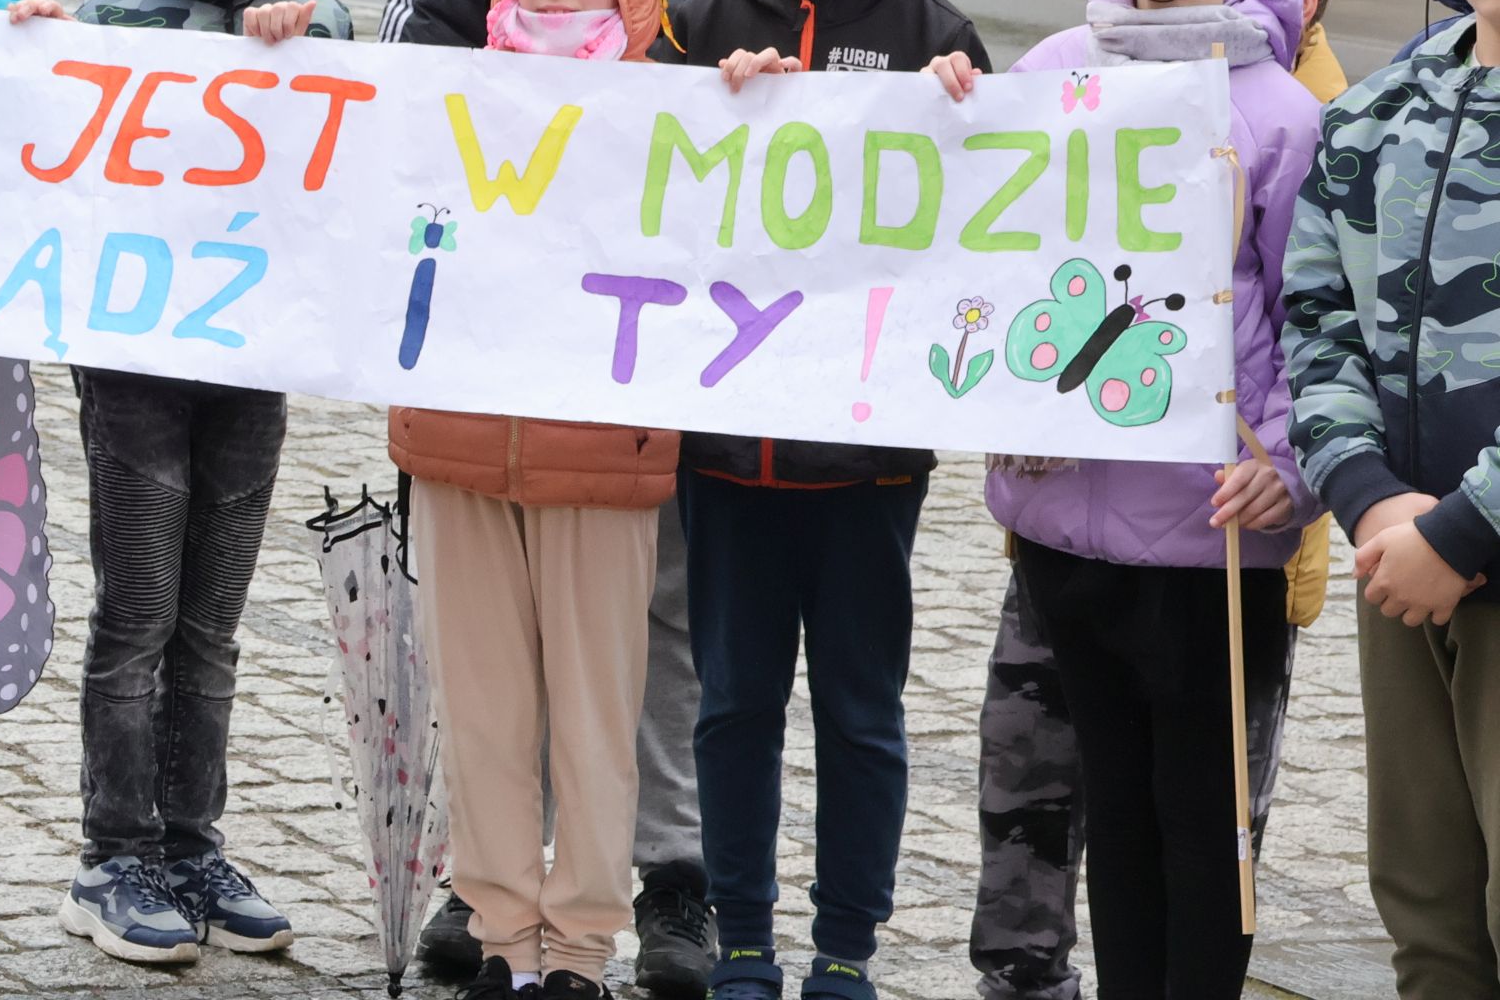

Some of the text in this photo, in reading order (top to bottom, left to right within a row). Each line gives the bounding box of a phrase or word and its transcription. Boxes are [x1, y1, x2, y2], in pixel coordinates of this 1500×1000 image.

[828, 46, 889, 70] #URBN
[21, 59, 376, 191] JEST
[445, 93, 583, 215] W
[641, 111, 1183, 252] MODZIE
